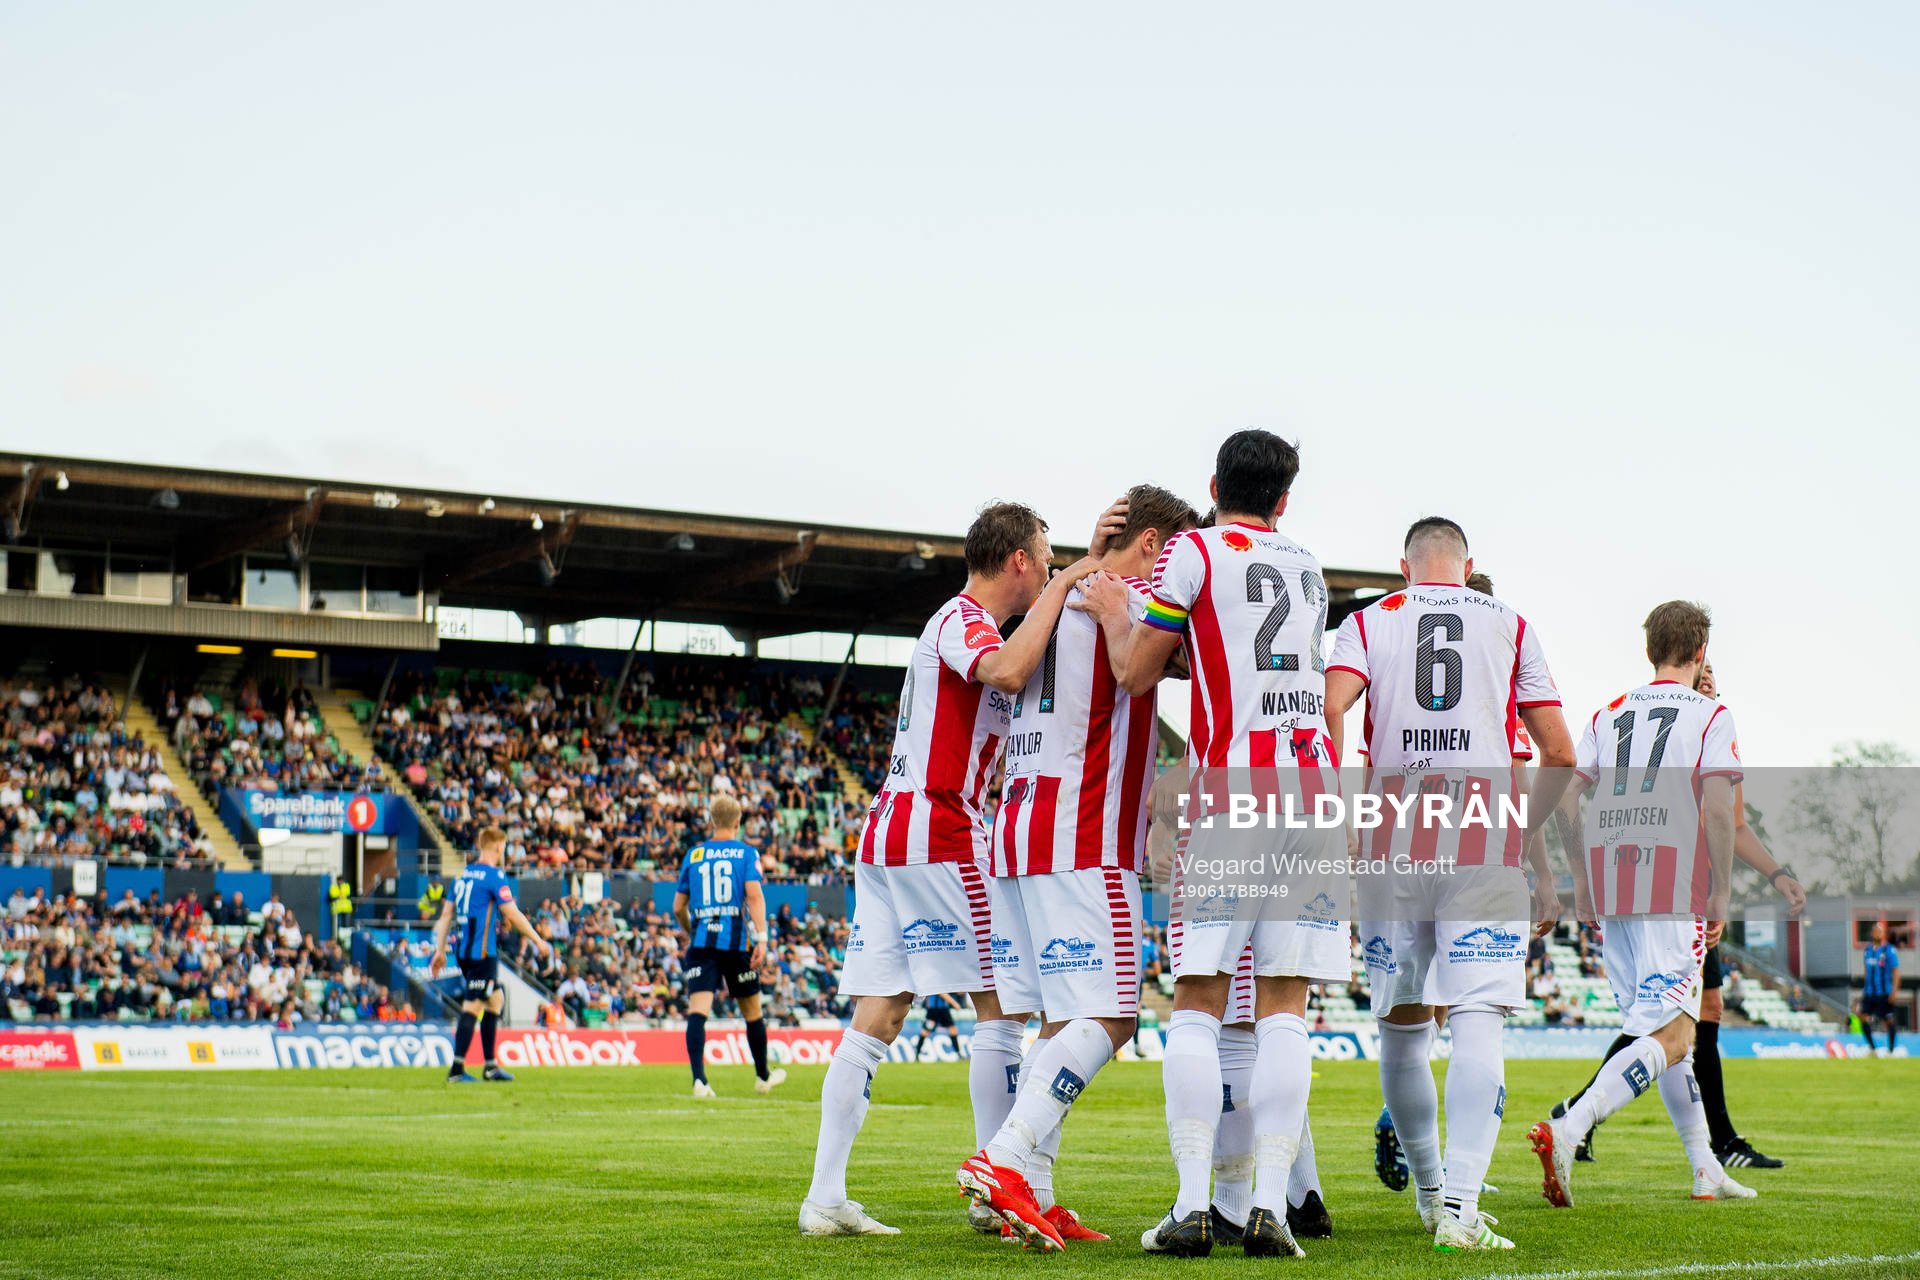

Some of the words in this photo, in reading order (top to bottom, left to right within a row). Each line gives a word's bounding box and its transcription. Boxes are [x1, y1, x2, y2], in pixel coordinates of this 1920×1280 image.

[1412, 594, 1459, 606] TROMS
[1464, 595, 1505, 613] KRAFT
[1414, 613, 1464, 712] 6
[1261, 690, 1324, 717] WANGBE
[1630, 693, 1666, 702] TROMS
[1007, 731, 1043, 759] TAYLOR
[1402, 728, 1471, 752] PIRINEN
[1613, 706, 1680, 796] 17
[250, 792, 345, 817] SpareBank
[354, 801, 368, 826] 1
[1599, 806, 1669, 829] BERNTSEN
[706, 848, 745, 860] BACKE
[1613, 845, 1654, 866] MOT
[698, 859, 733, 906] 16
[919, 940, 953, 948] MADSEN
[1478, 950, 1513, 958] MADSEN
[1091, 958, 1103, 966] AS
[0, 1040, 69, 1062] candic
[276, 1035, 455, 1069] macron
[497, 1030, 641, 1067] altibox
